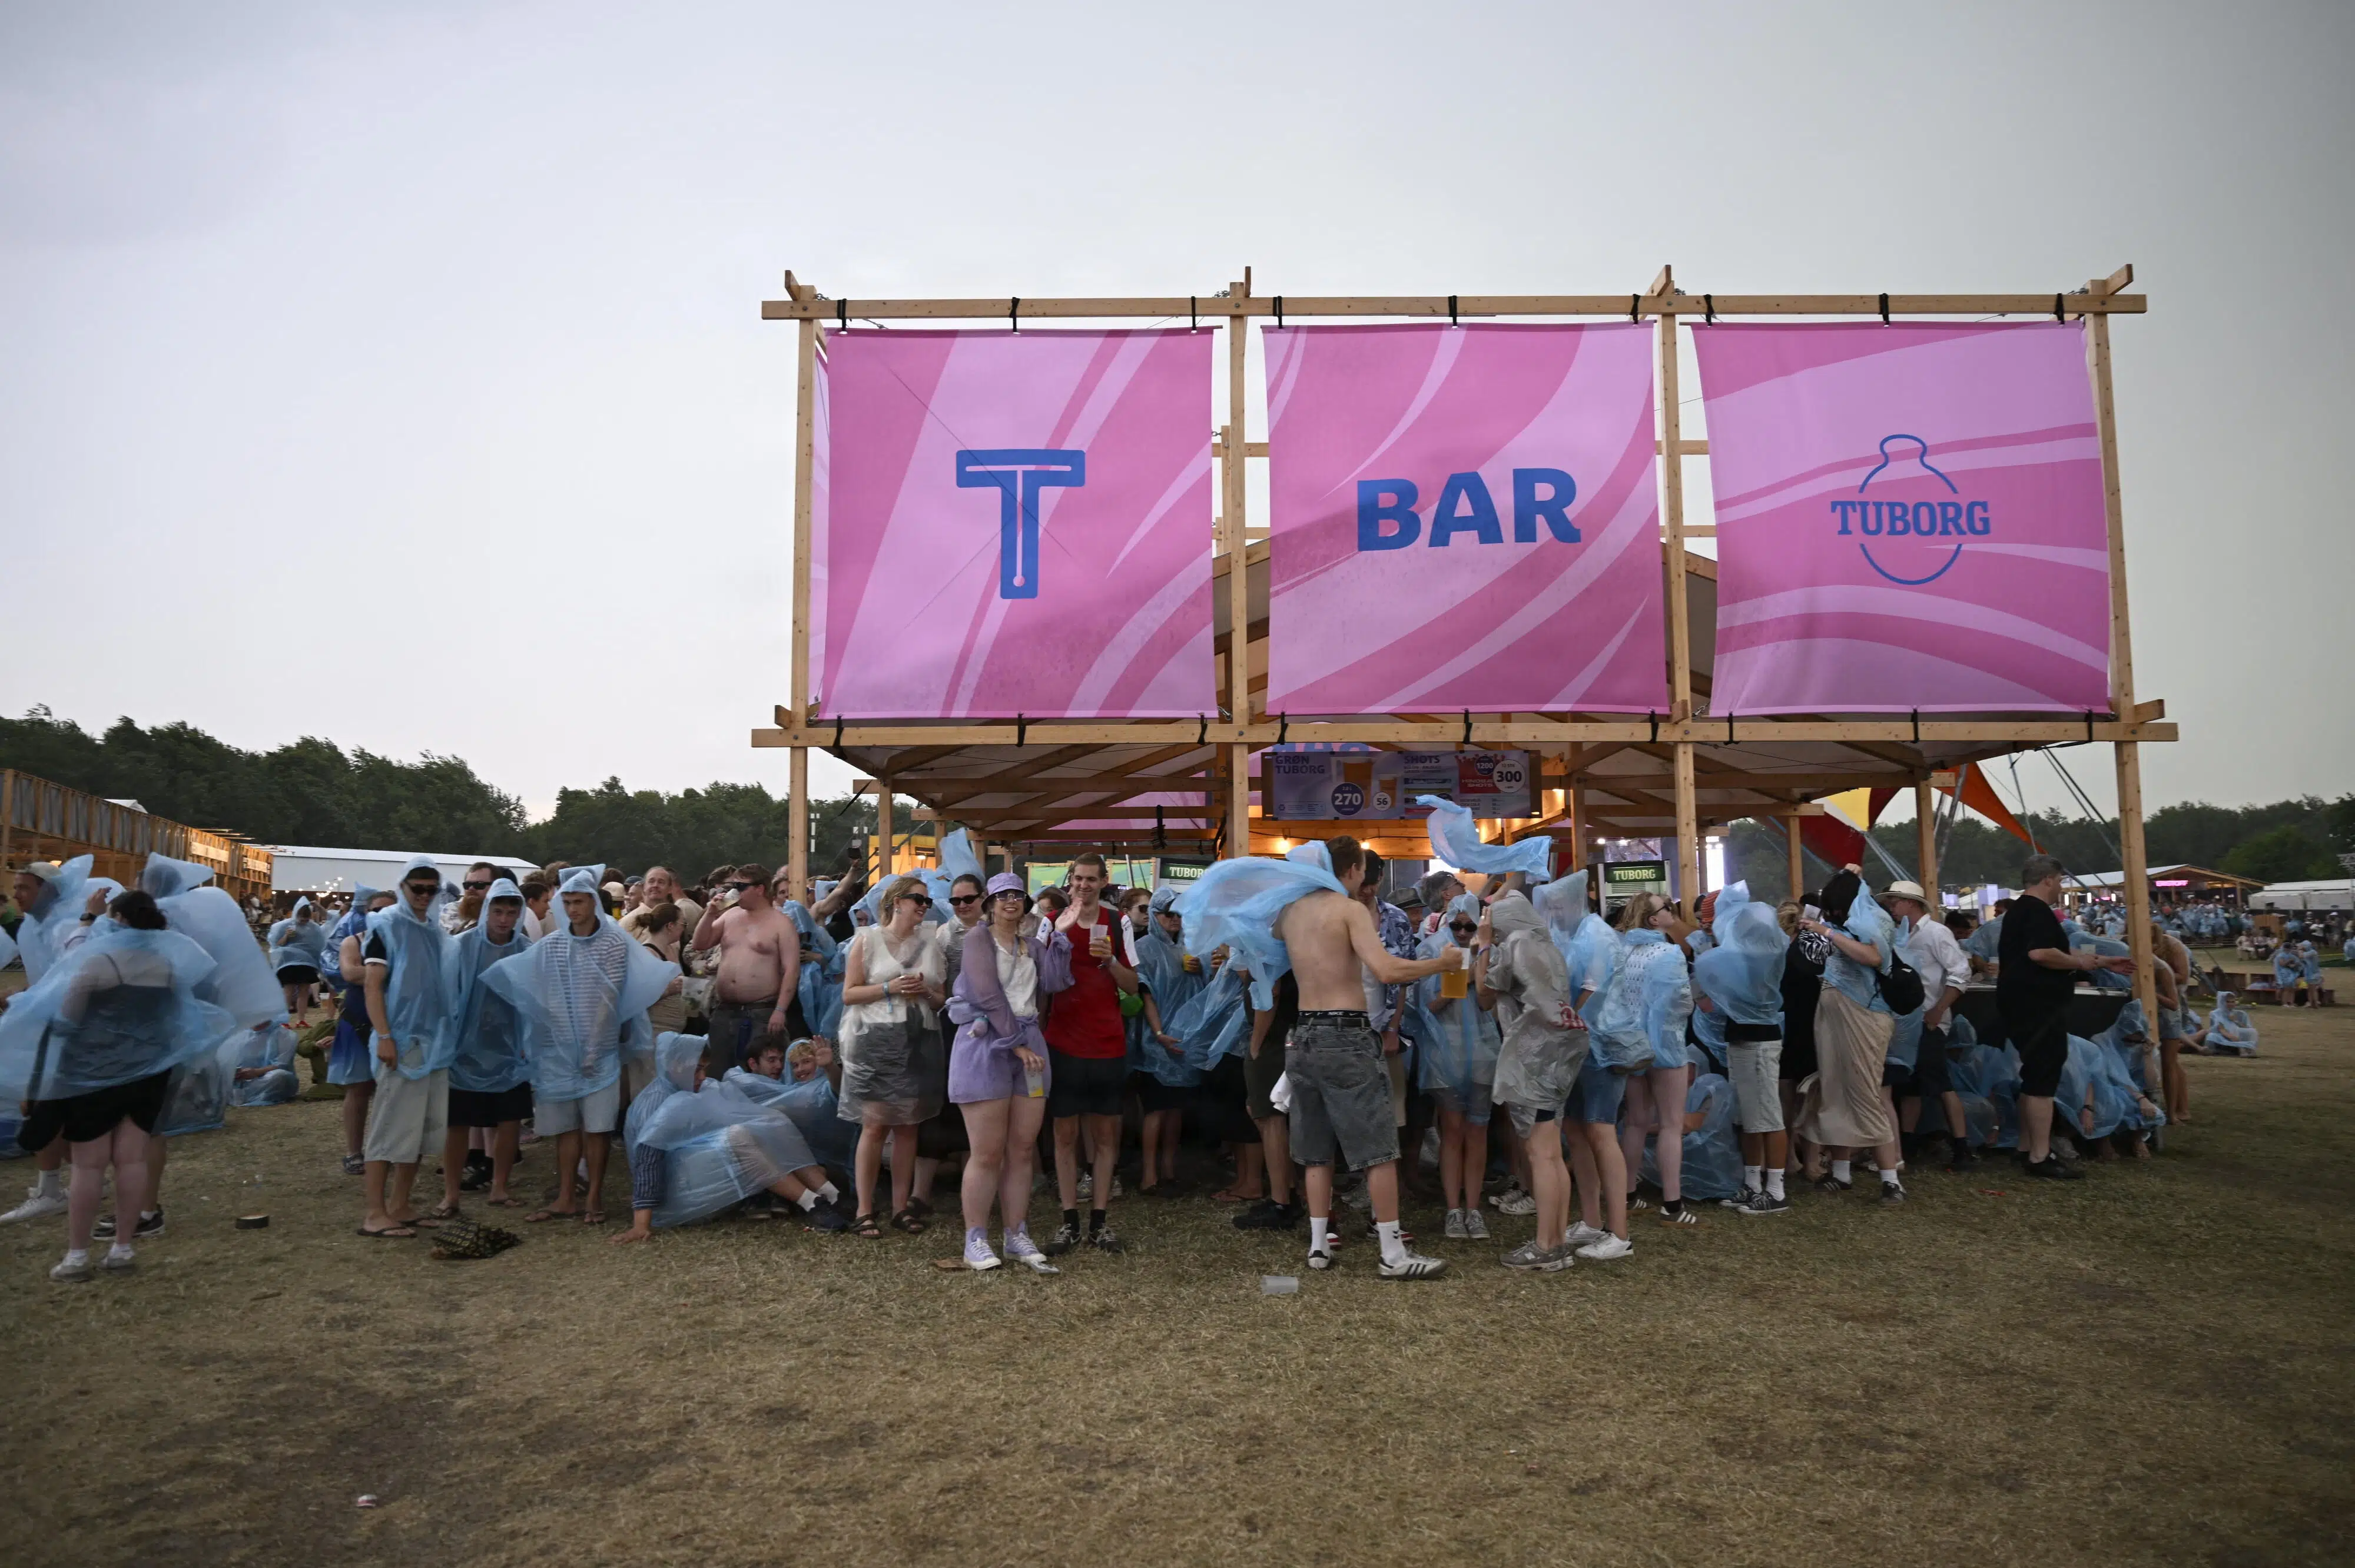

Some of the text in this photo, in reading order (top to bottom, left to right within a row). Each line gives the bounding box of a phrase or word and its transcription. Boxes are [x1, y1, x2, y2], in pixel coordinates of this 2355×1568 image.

[956, 449, 1581, 599] T BAR
[1830, 501, 1991, 536] TUBORG
[1275, 755, 1310, 764] GRØN
[1404, 755, 1440, 764] SHOTS
[1275, 765, 1325, 774] TUBORG
[1496, 770, 1522, 782] 300
[1335, 793, 1361, 805] 270
[1169, 866, 1207, 878] TUBOR
[1613, 869, 1656, 881] TUBORG
